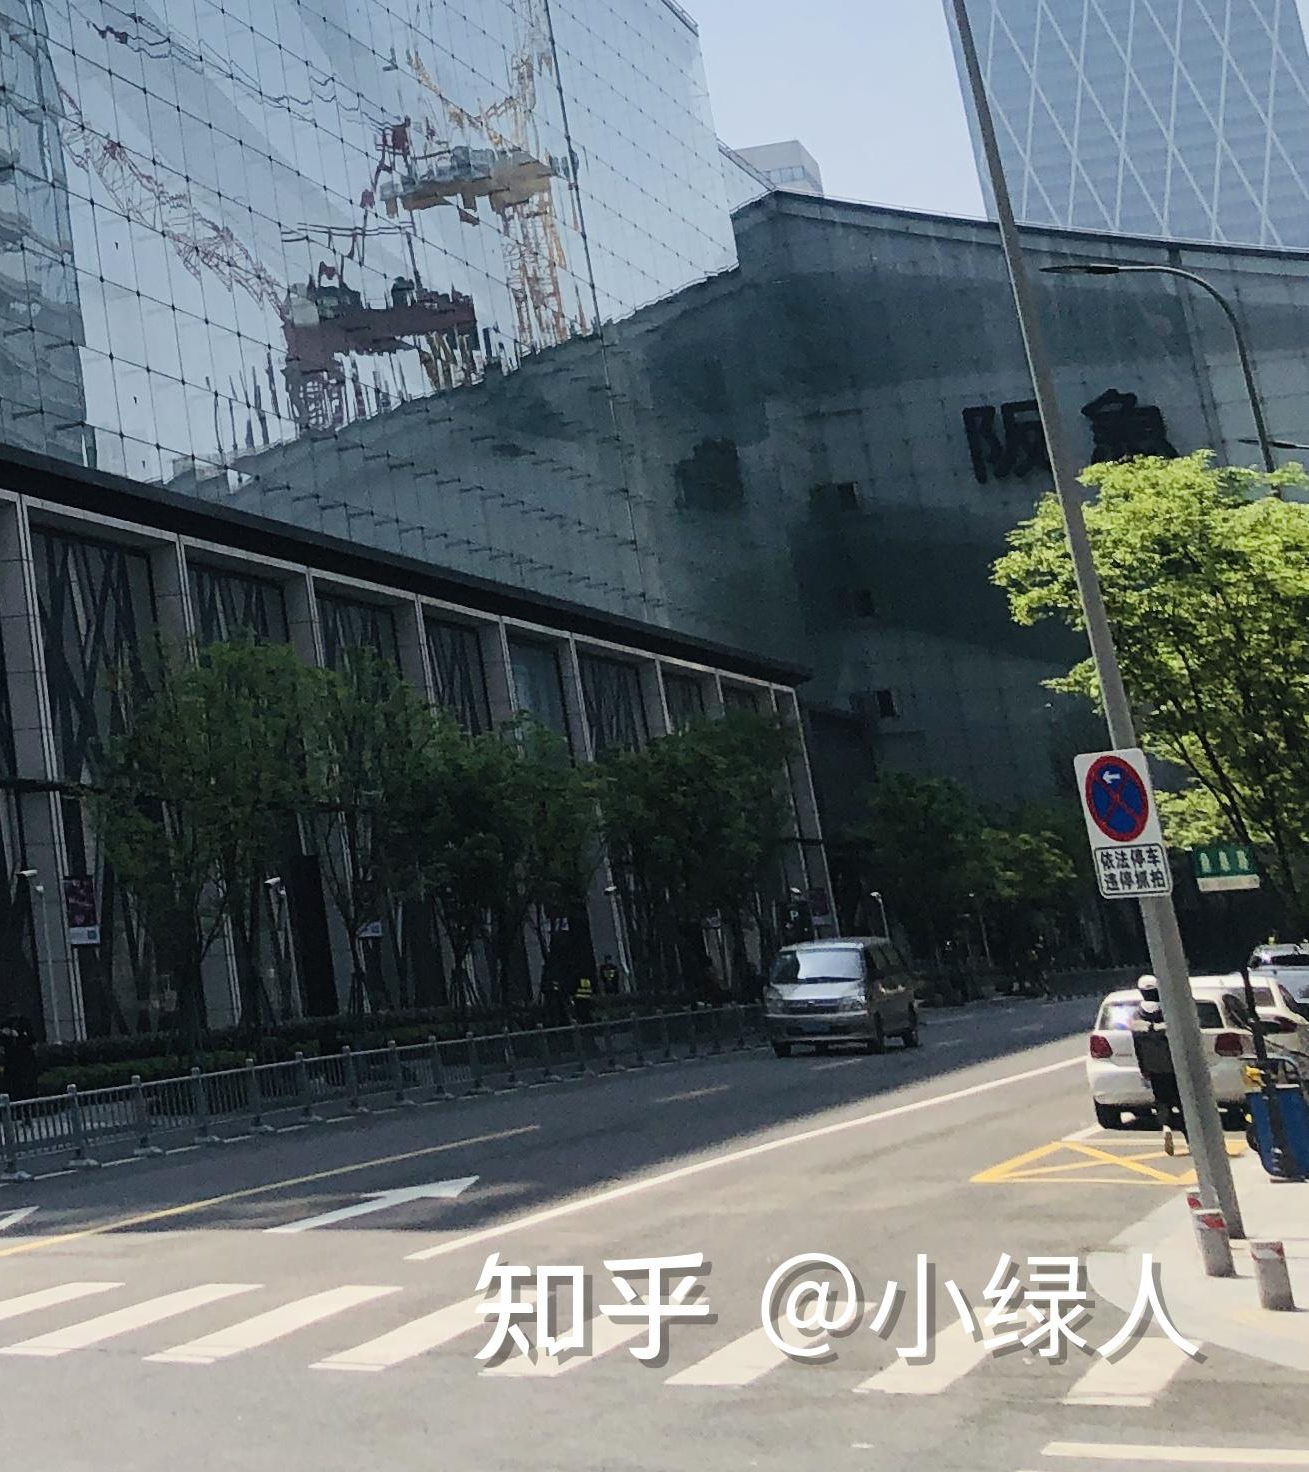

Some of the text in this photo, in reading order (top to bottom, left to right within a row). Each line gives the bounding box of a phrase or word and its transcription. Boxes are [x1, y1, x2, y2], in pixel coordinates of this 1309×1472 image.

[1100, 847, 1161, 870] 依法停车
[1103, 868, 1166, 891] 违停抓拍
